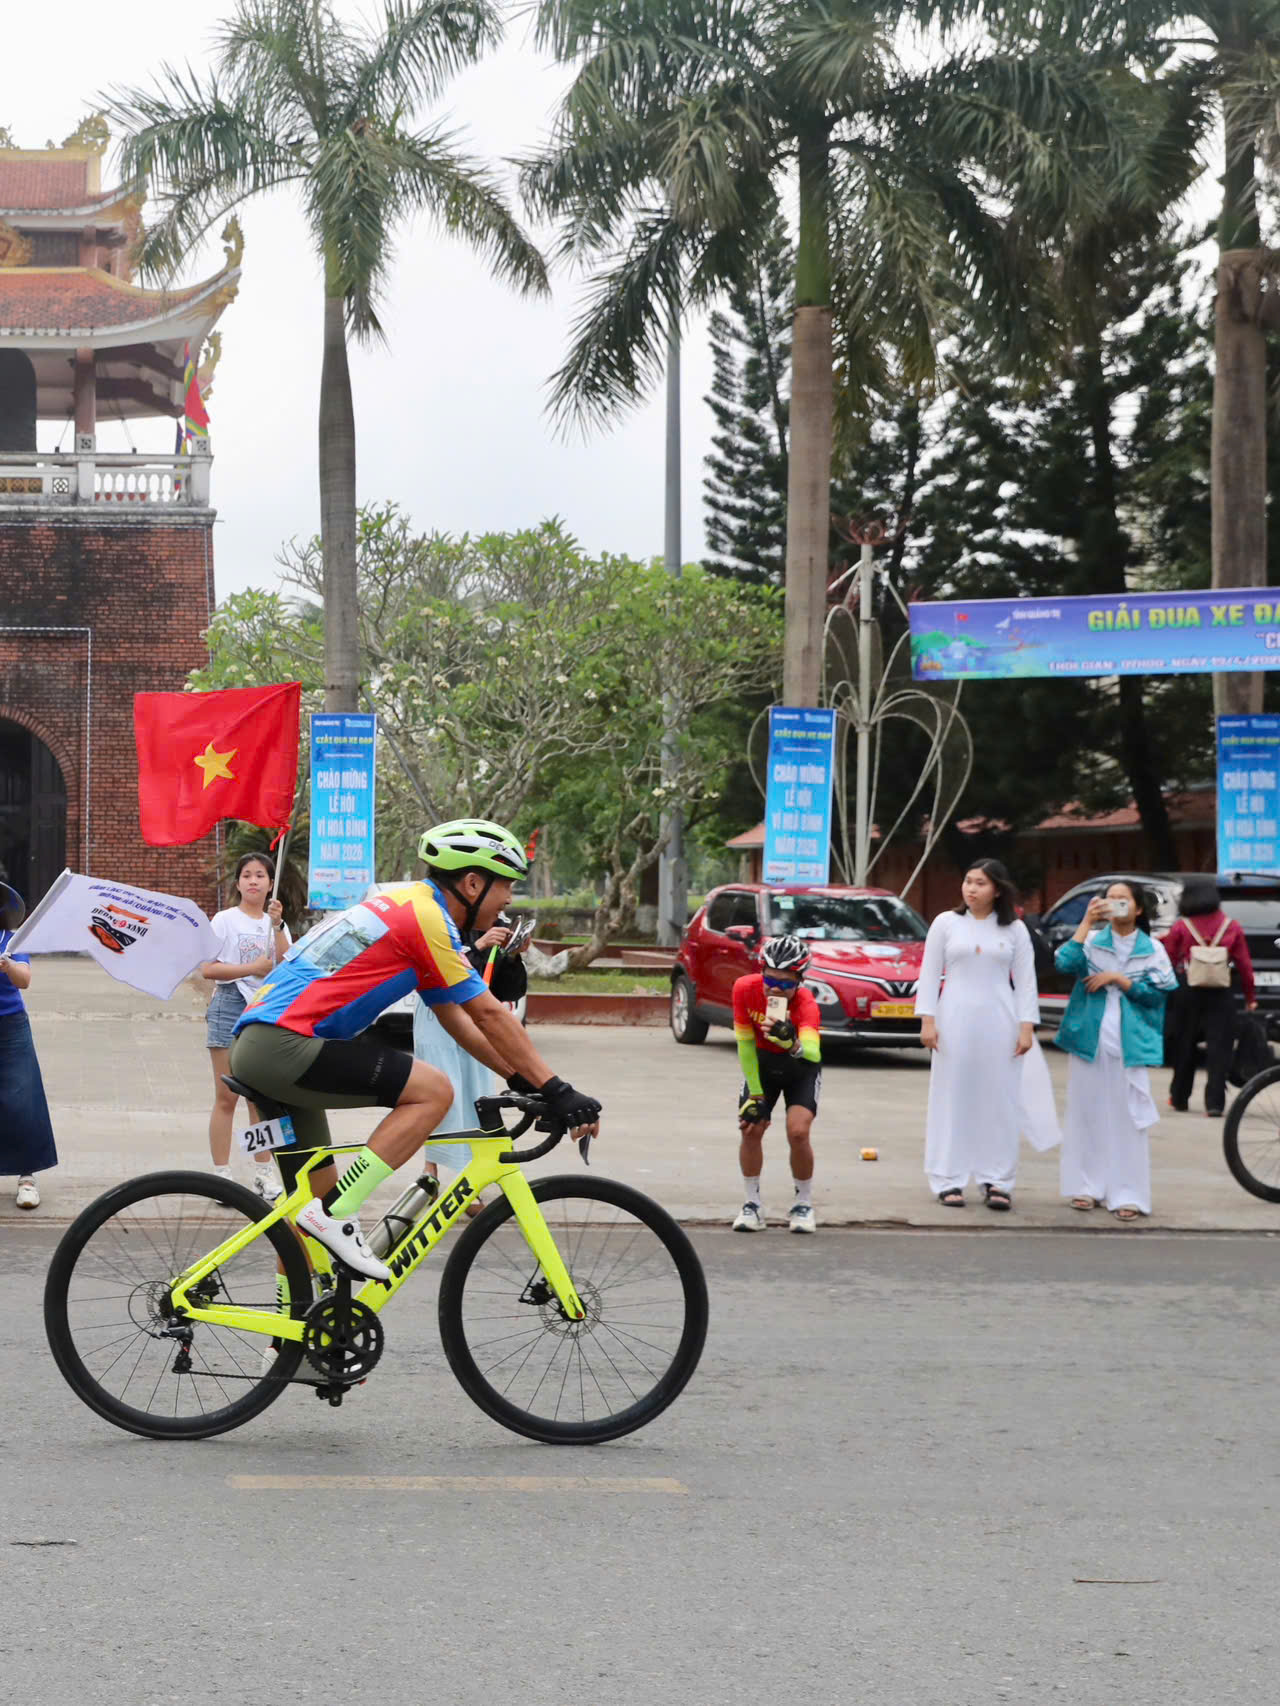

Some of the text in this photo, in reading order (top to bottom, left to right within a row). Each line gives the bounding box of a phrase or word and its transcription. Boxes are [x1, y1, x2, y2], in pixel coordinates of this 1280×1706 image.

[1088, 602, 1140, 632] GIẢI
[1148, 607, 1201, 629] ĐUA
[1211, 605, 1245, 627] XE
[317, 767, 368, 790] CHÀO MỪNG
[329, 789, 340, 813] LỄ
[346, 815, 368, 838] BÌNH
[245, 1125, 274, 1152] 241
[304, 1210, 328, 1233] Special
